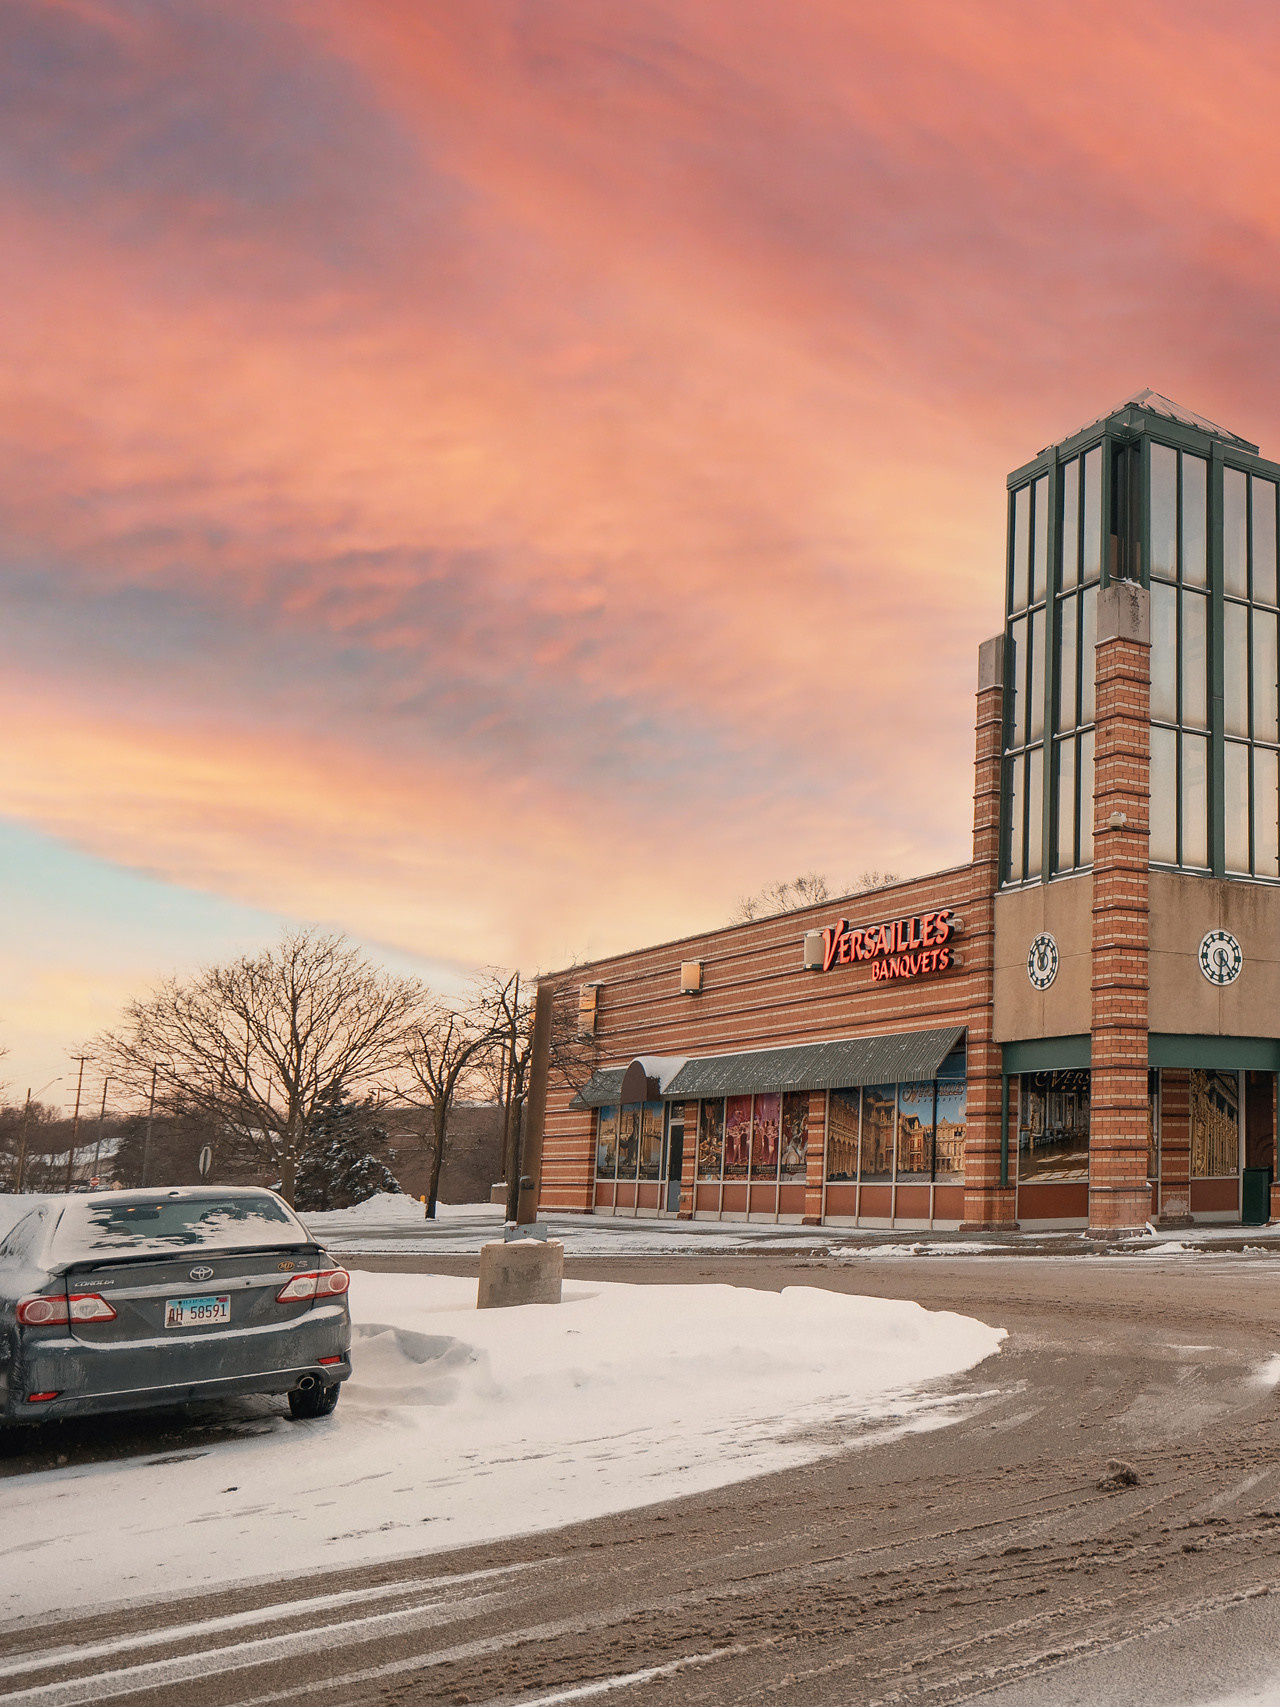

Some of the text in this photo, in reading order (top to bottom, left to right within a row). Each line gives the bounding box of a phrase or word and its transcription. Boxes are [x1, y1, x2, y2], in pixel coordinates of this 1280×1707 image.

[822, 910, 951, 971] VERSAILLES
[872, 948, 951, 981] BANQUETS
[169, 1304, 227, 1322] AH 58591
